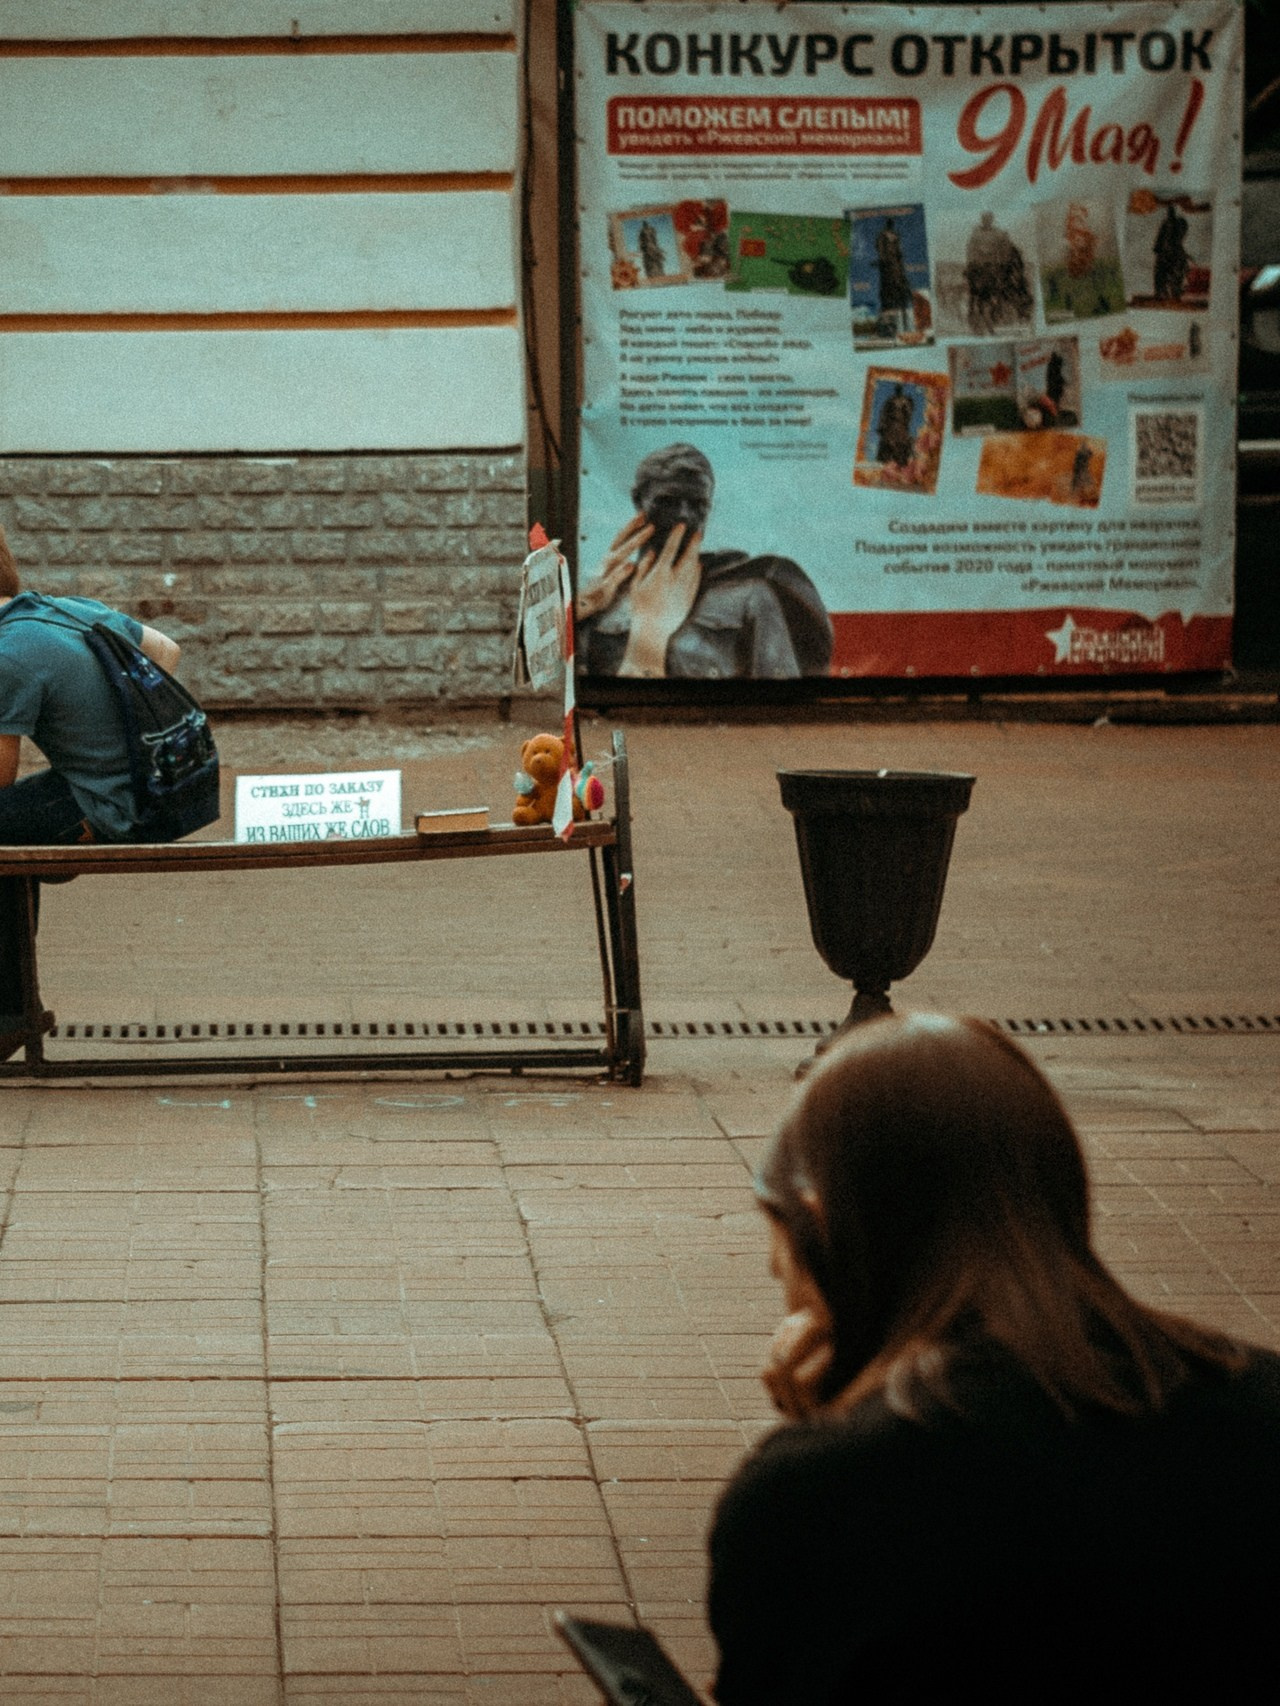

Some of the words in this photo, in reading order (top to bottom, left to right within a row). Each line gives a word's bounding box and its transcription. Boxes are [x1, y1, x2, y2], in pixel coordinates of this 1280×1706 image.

[606, 32, 874, 77] КОНКУРС
[891, 29, 1214, 78] ОТКРЫТОК
[617, 106, 771, 129] ПОМОЖЕМ
[777, 106, 910, 129] СЛЕПЫМ!
[947, 82, 1027, 190] 9
[1026, 78, 1207, 186] Мая!
[250, 783, 299, 799] СТИХИ
[305, 783, 324, 797] ПО
[329, 780, 385, 795] ЗАКАЗУ
[282, 801, 328, 818] ЗДЕСЬ
[331, 800, 354, 815] ЖЕ
[246, 826, 267, 843] ИЗ
[270, 823, 320, 842] ВАШИХ
[325, 821, 348, 840] ЖЕ
[351, 818, 390, 837] СЛОВ
